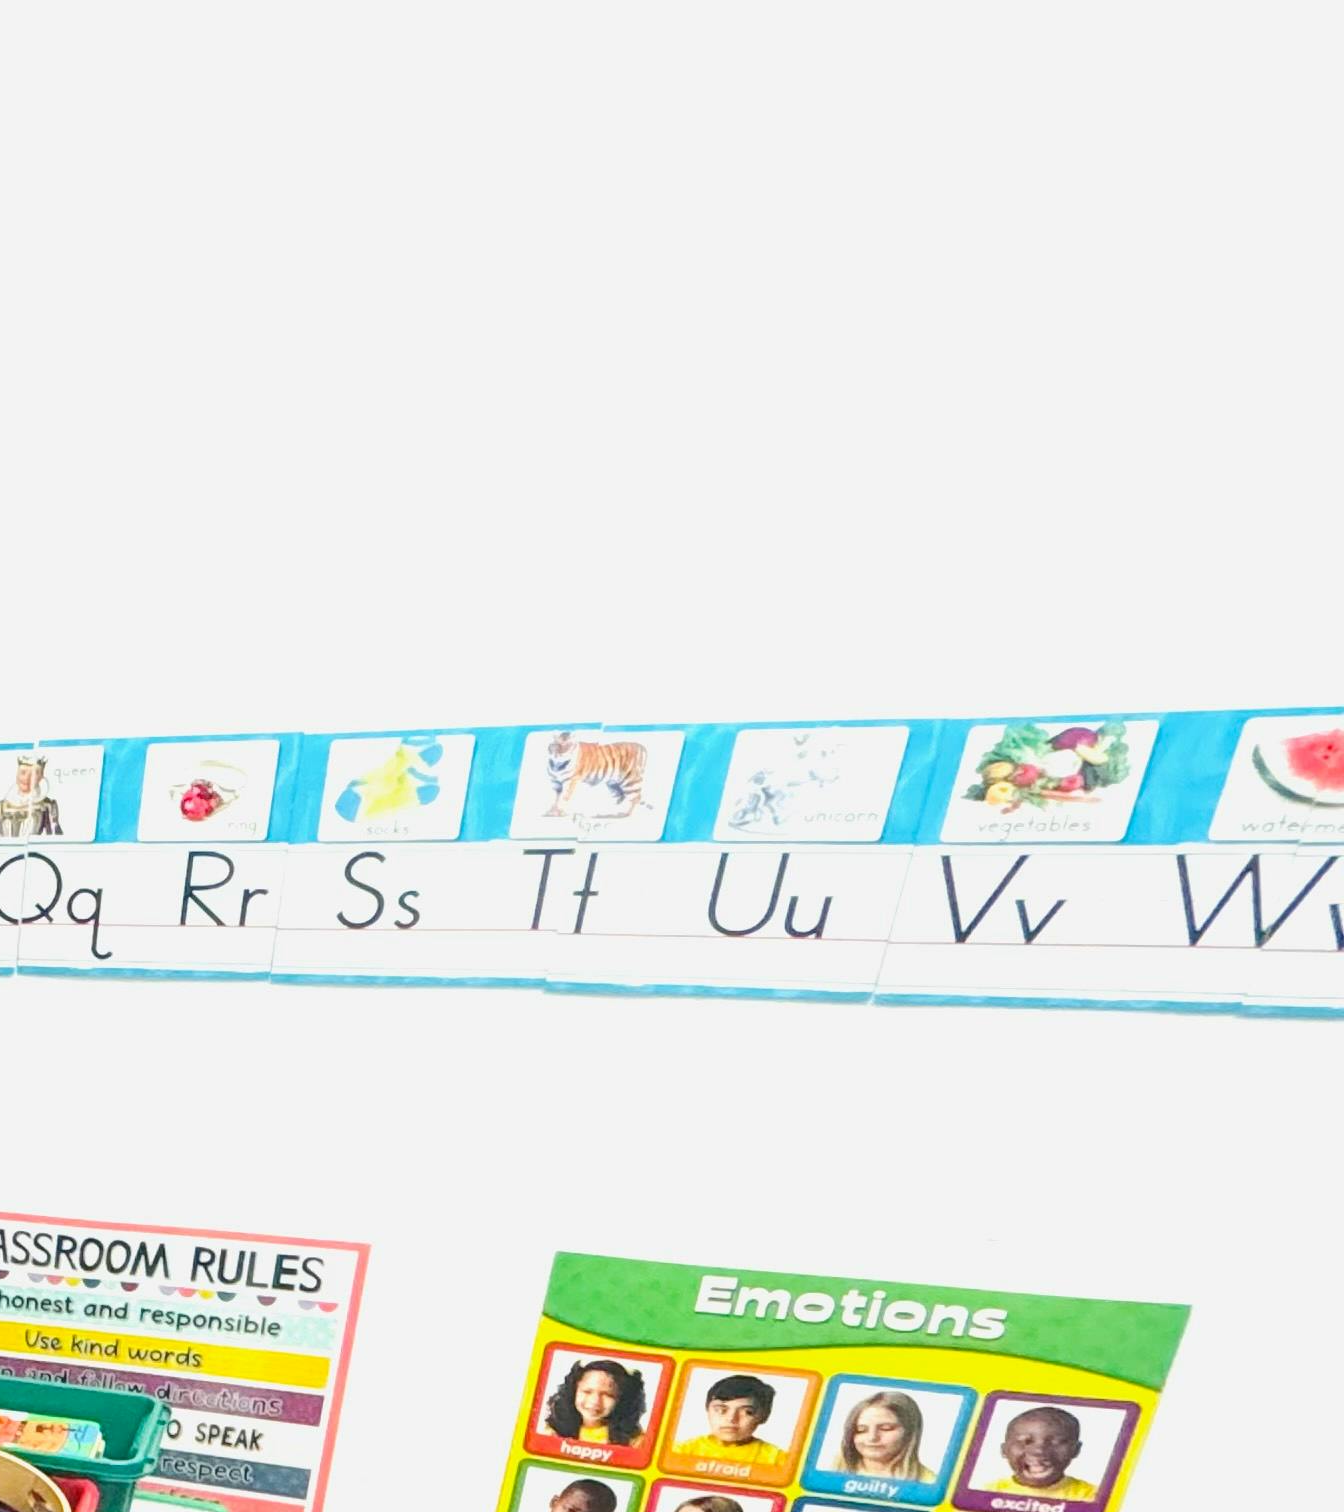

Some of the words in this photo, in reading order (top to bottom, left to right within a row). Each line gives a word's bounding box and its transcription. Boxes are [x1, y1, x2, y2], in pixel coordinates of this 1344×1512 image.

[54, 765, 96, 784] queen
[803, 808, 879, 825] unicorn
[976, 817, 1091, 842] vegetables
[1240, 815, 1344, 835] waterme
[180, 850, 269, 928] Rr
[335, 850, 421, 931] Ss
[522, 847, 600, 935] Tt
[707, 852, 834, 941] Uu
[940, 853, 1067, 944] Vv
[190, 1246, 325, 1293] RULES
[83, 1301, 129, 1321] and
[139, 1305, 282, 1337] responsible
[693, 1275, 1009, 1342] Emotions
[24, 1328, 63, 1352] Use
[70, 1335, 120, 1358] kind
[127, 1346, 203, 1369] words
[156, 1384, 283, 1417] directions
[195, 1421, 265, 1451] SPEAK
[559, 1440, 613, 1464] happy
[161, 1455, 255, 1484] respect
[695, 1459, 751, 1479] afraid
[843, 1477, 900, 1498] guilty
